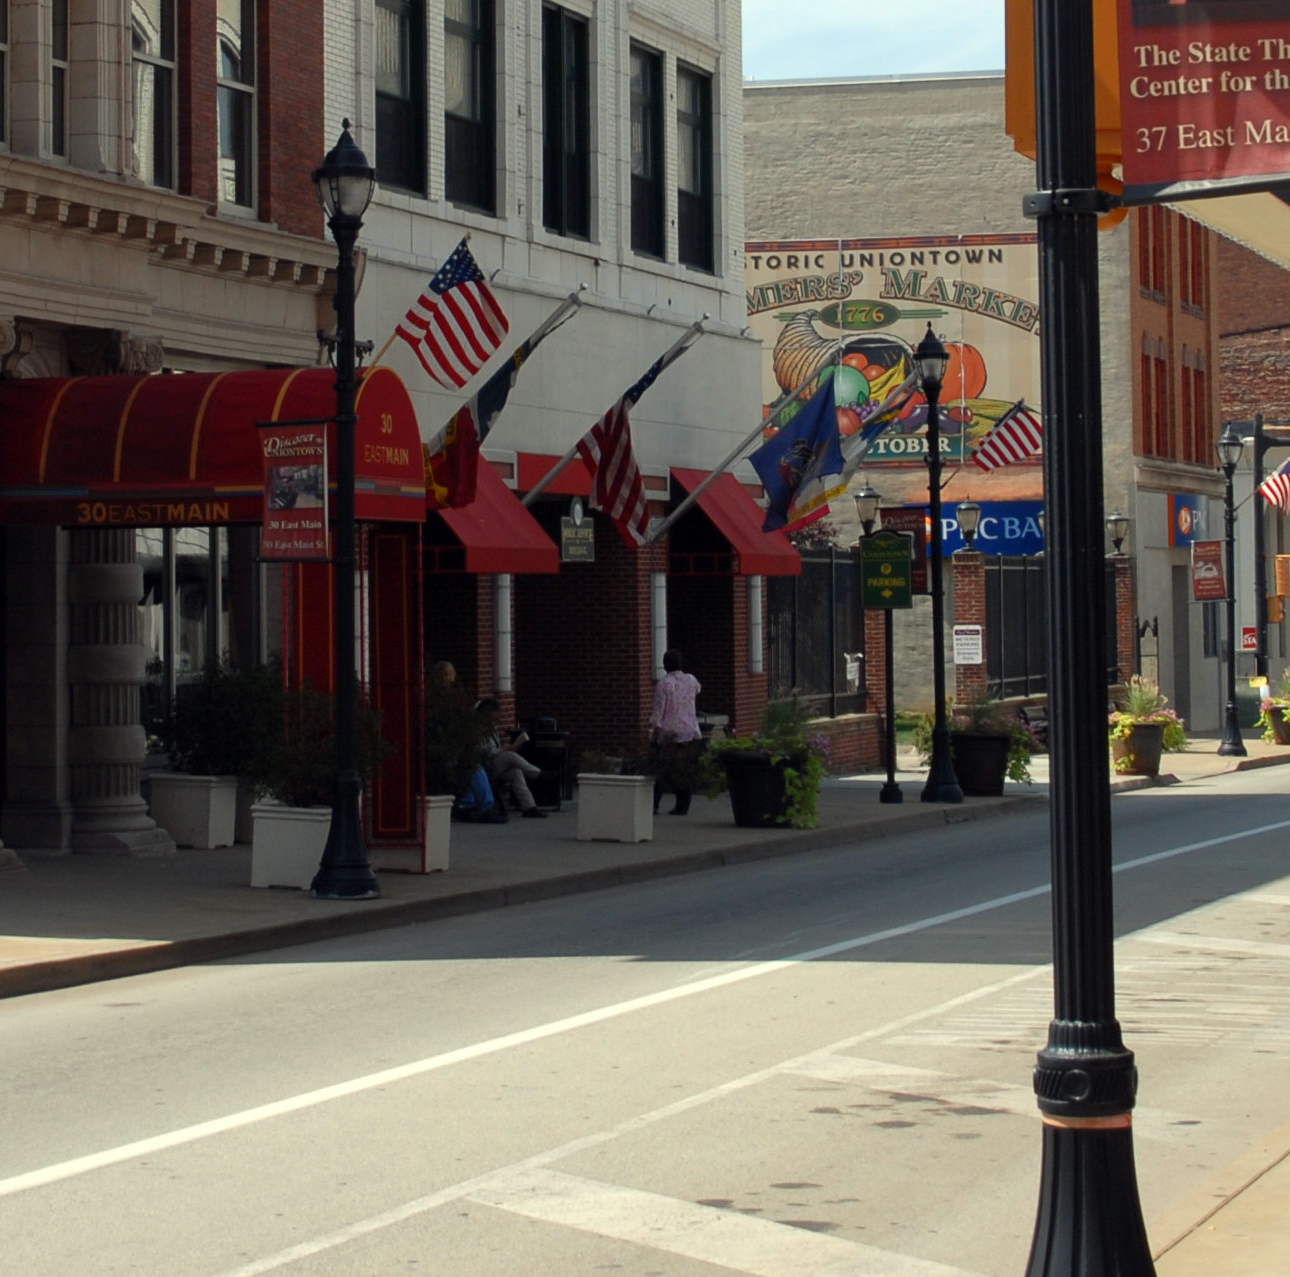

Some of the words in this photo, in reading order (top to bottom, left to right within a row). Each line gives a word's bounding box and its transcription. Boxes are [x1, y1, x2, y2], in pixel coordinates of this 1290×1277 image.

[1134, 45, 1181, 68] The
[1188, 41, 1251, 64] State
[1130, 76, 1213, 99] Center
[1220, 70, 1257, 92] for
[1136, 126, 1167, 152] 37
[1177, 121, 1236, 150] East
[744, 254, 824, 269] TORIC
[840, 248, 1003, 268] UNIONTOWN
[879, 267, 1040, 336] MARKE
[836, 307, 885, 323] 1776
[380, 413, 393, 434] 30
[866, 437, 952, 455] TOBR
[281, 520, 298, 529] East
[301, 519, 322, 529] Main
